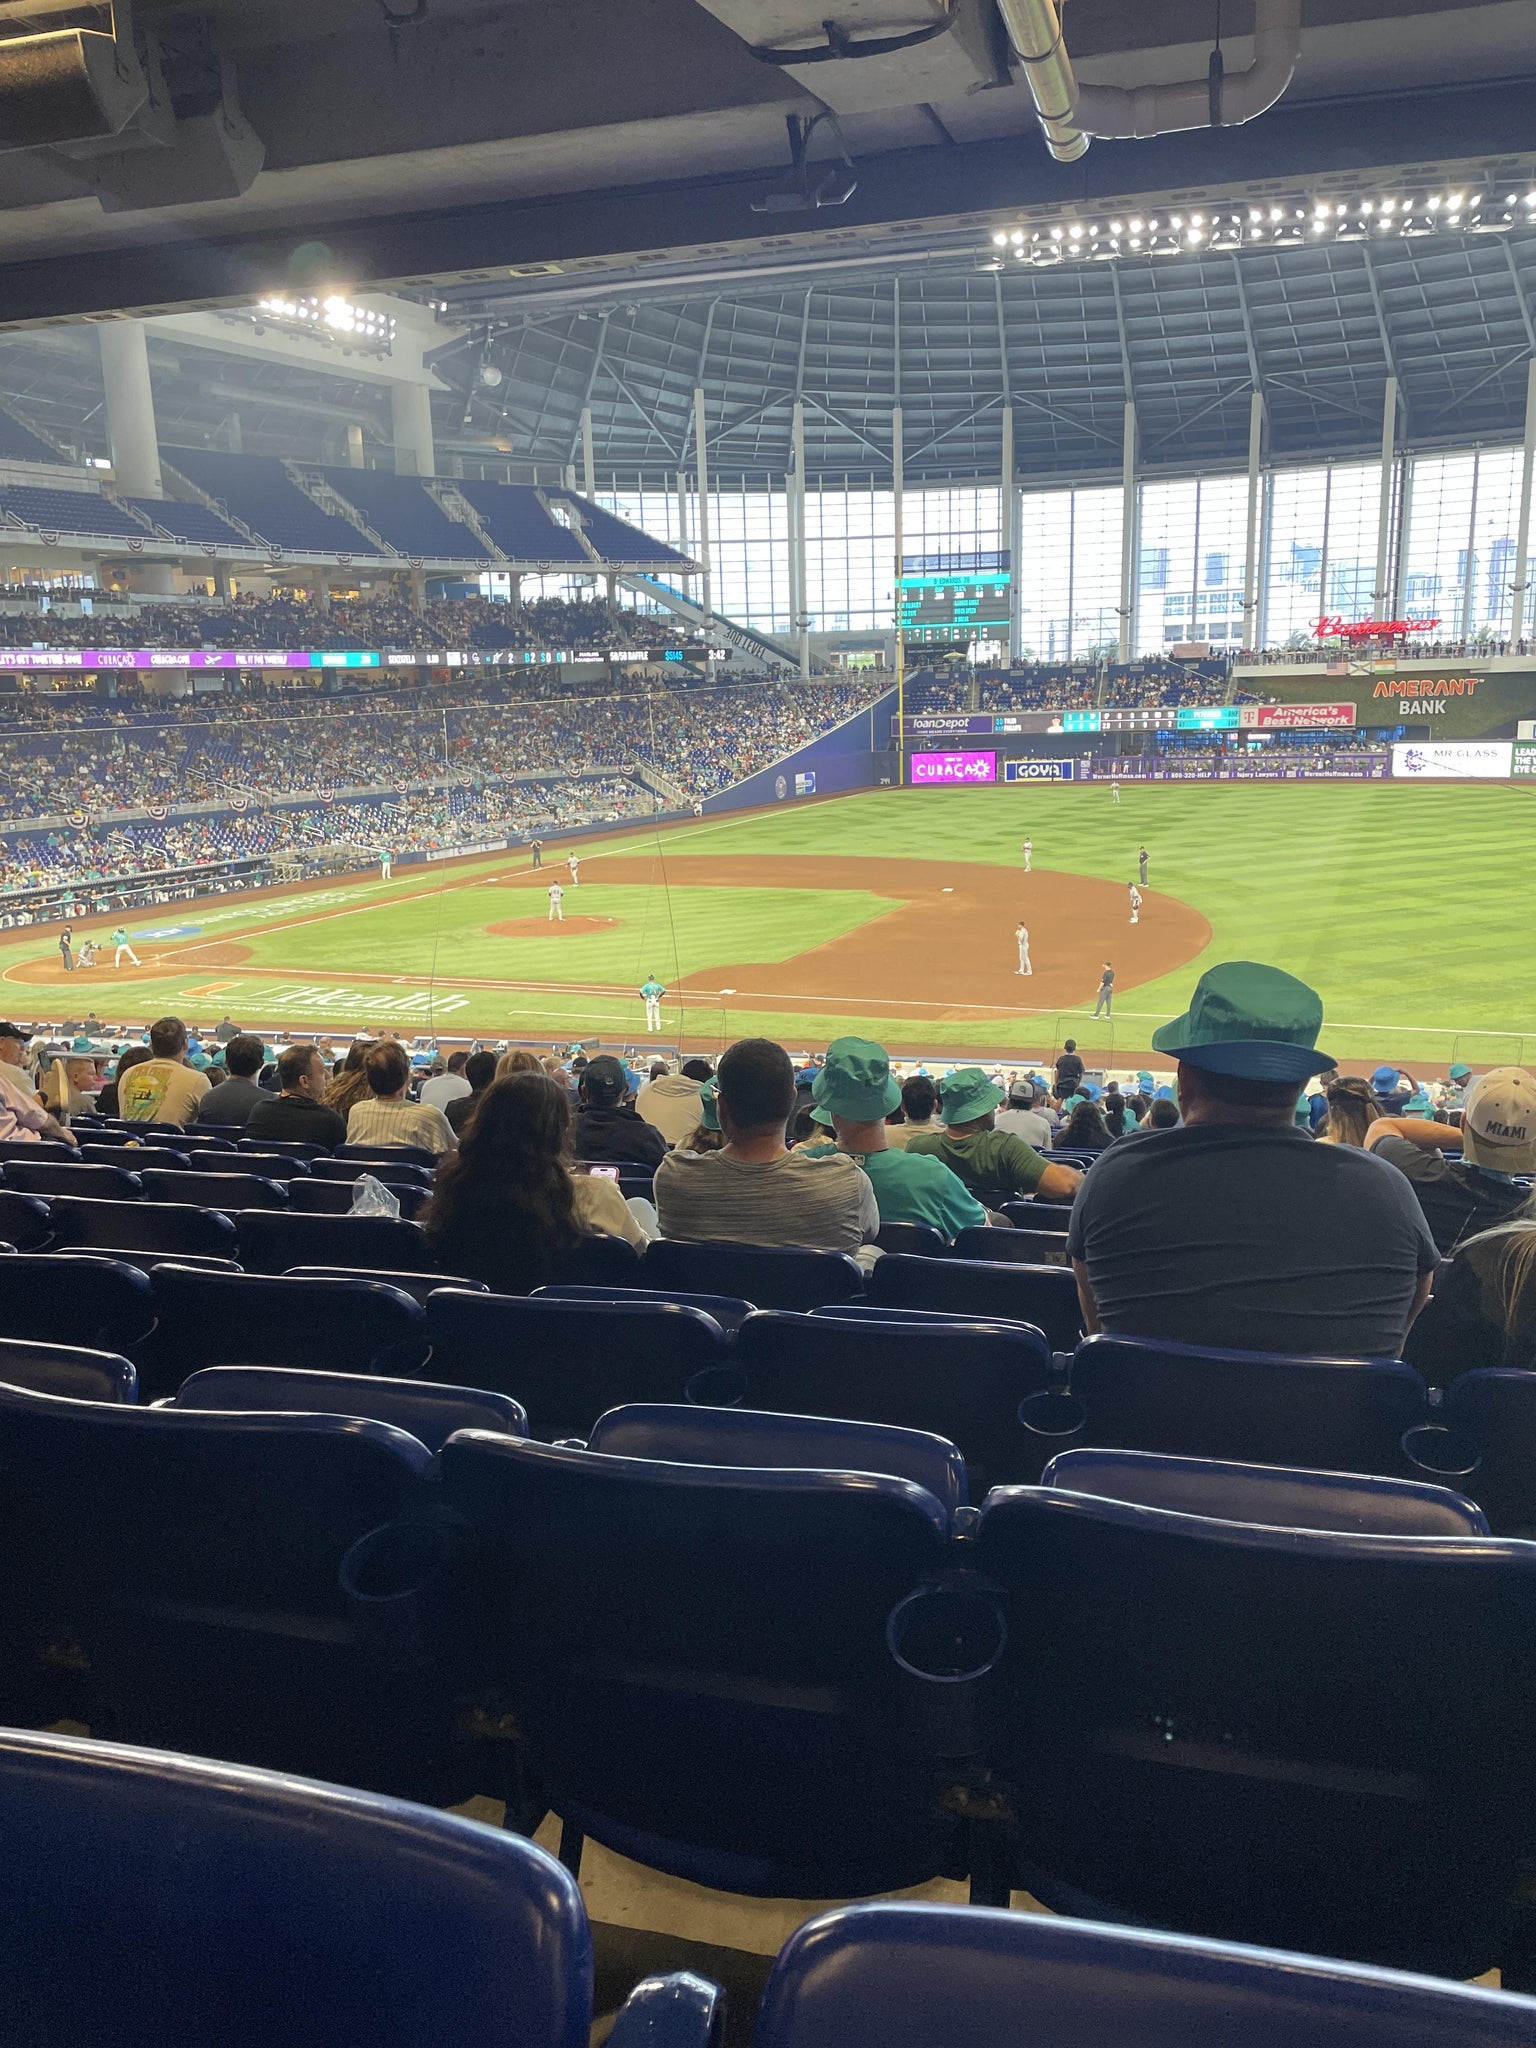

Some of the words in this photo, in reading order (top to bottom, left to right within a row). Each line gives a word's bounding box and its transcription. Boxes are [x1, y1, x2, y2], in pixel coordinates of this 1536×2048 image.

[742, 637, 766, 659] LEVEL
[1373, 679, 1478, 698] AMERANT
[1273, 706, 1338, 716] America's
[1399, 700, 1446, 715] BANK
[913, 718, 970, 729] loanDepot
[1263, 717, 1291, 726] Best
[1293, 715, 1349, 726] Network
[1018, 765, 1060, 777] GOYA
[1485, 1120, 1527, 1140] MIAMI
